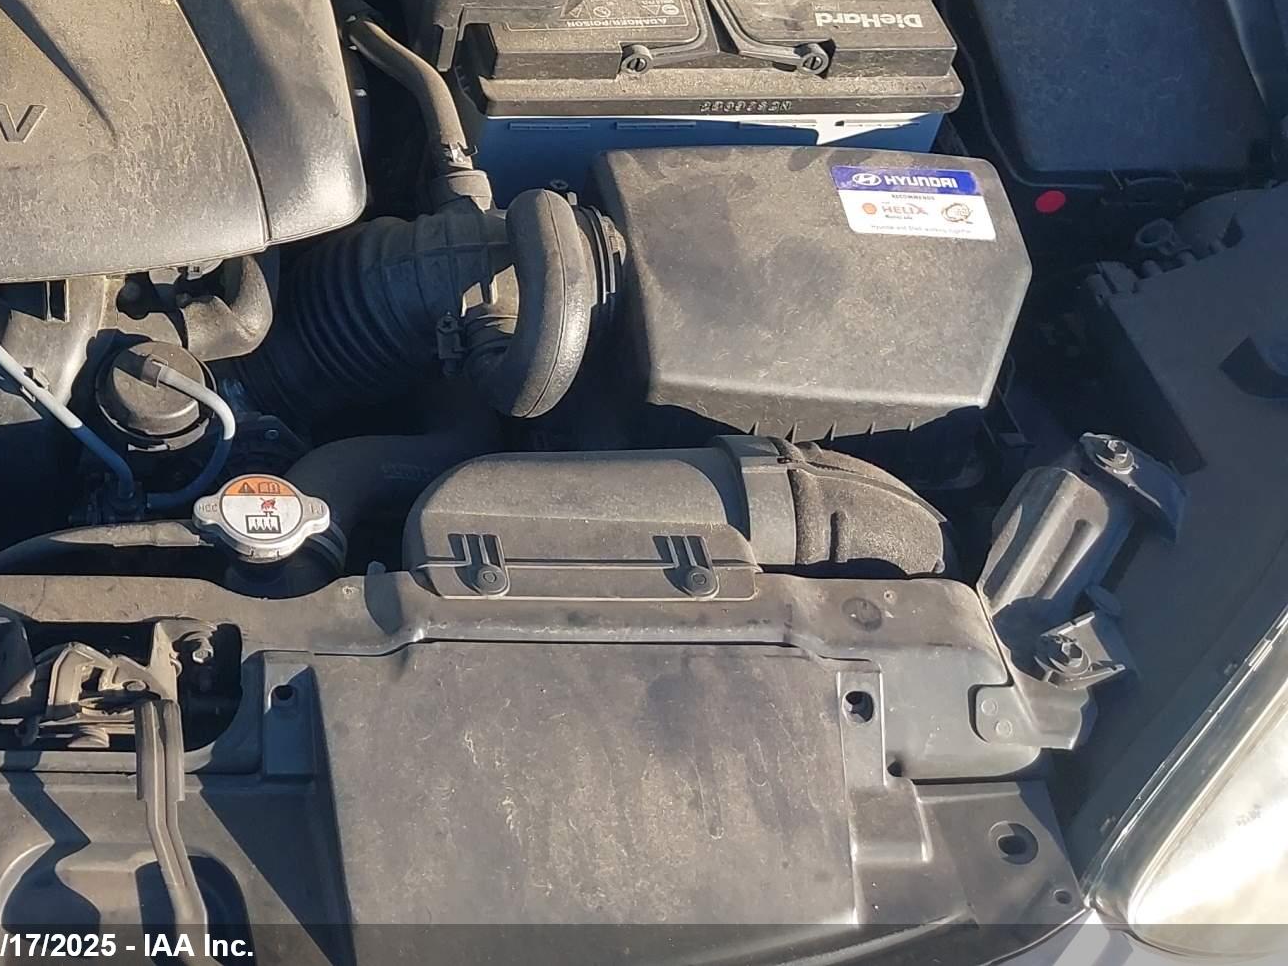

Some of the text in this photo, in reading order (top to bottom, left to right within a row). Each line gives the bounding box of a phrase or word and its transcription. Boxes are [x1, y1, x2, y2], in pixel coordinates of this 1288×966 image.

[814, 12, 924, 28] DieHard
[884, 175, 959, 189] HYUNDAI
[882, 202, 929, 216] HELIX
